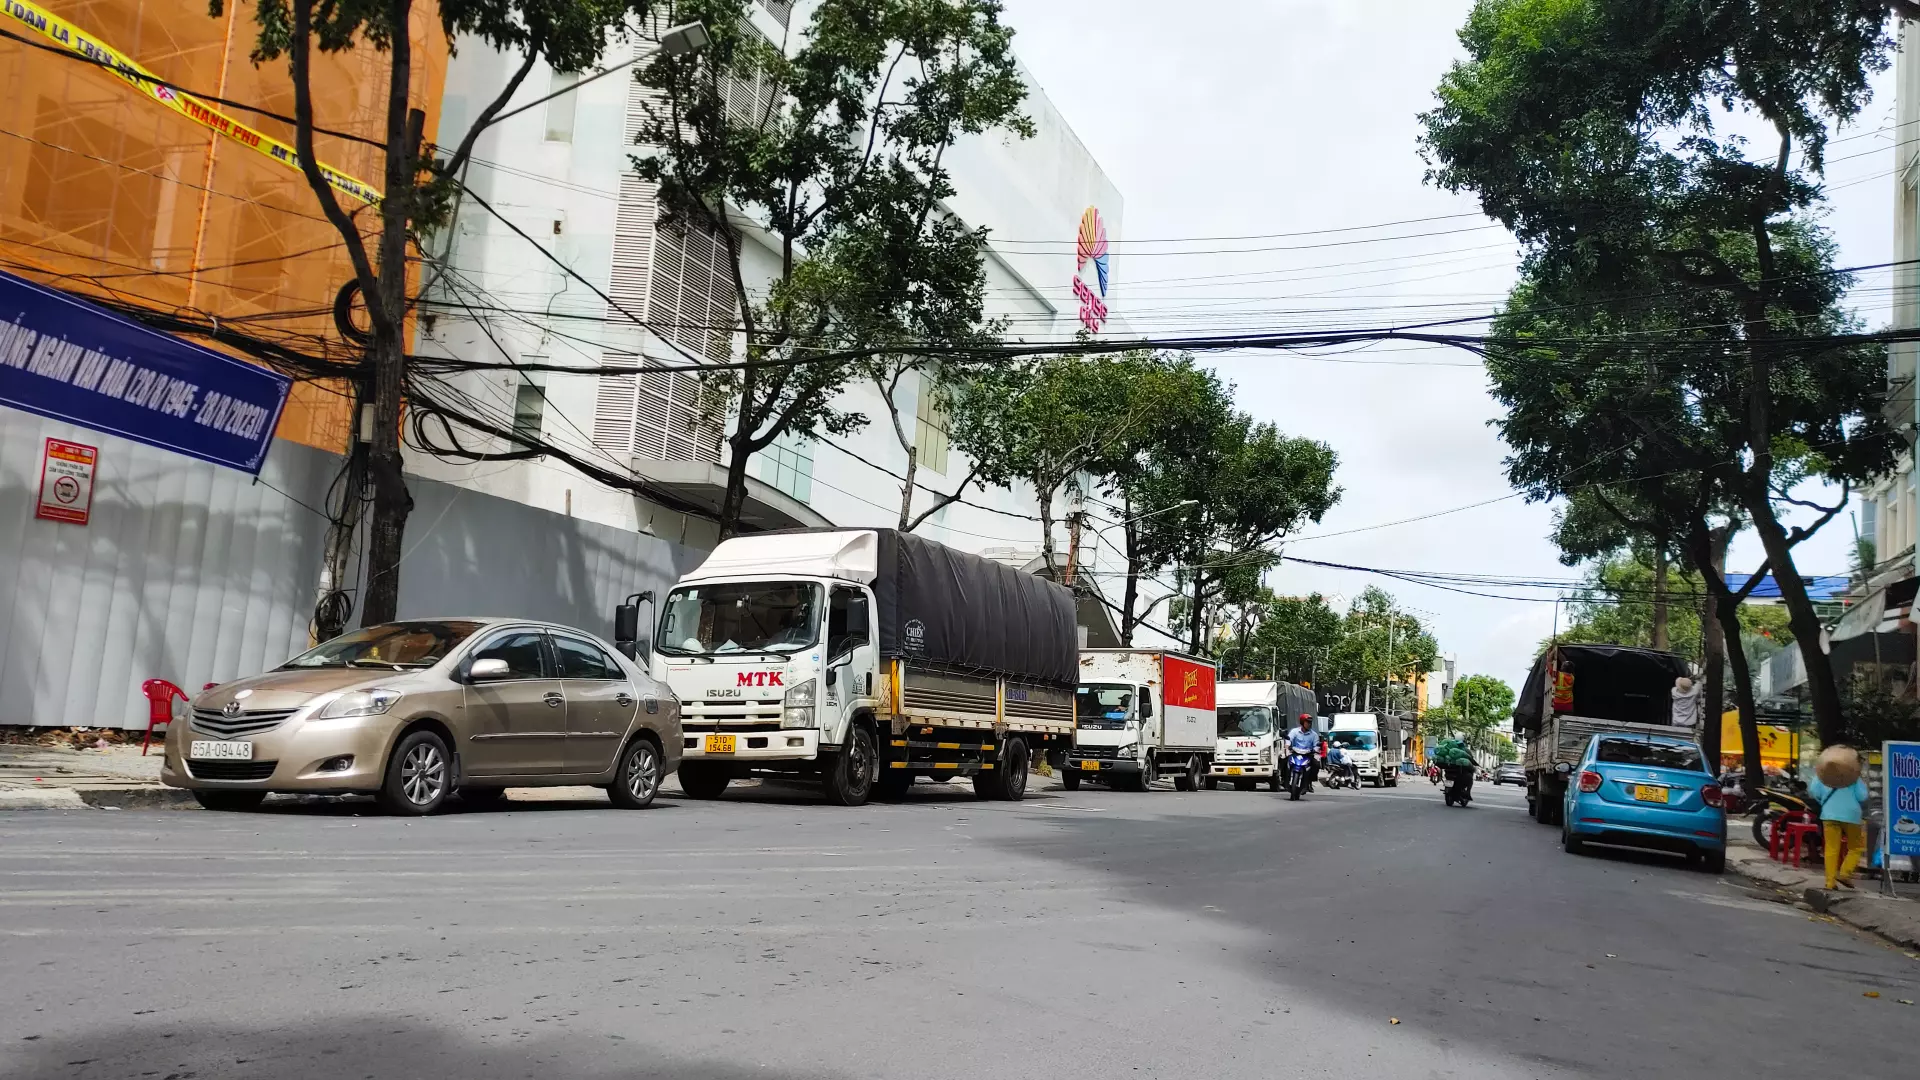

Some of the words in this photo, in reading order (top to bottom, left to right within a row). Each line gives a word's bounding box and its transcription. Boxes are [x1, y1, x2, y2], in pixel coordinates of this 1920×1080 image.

[26, 333, 84, 383] NGÀNH
[736, 671, 785, 687] MTK
[706, 689, 741, 697] ISUZU
[713, 736, 728, 744] 51D
[709, 744, 732, 752] 154.68
